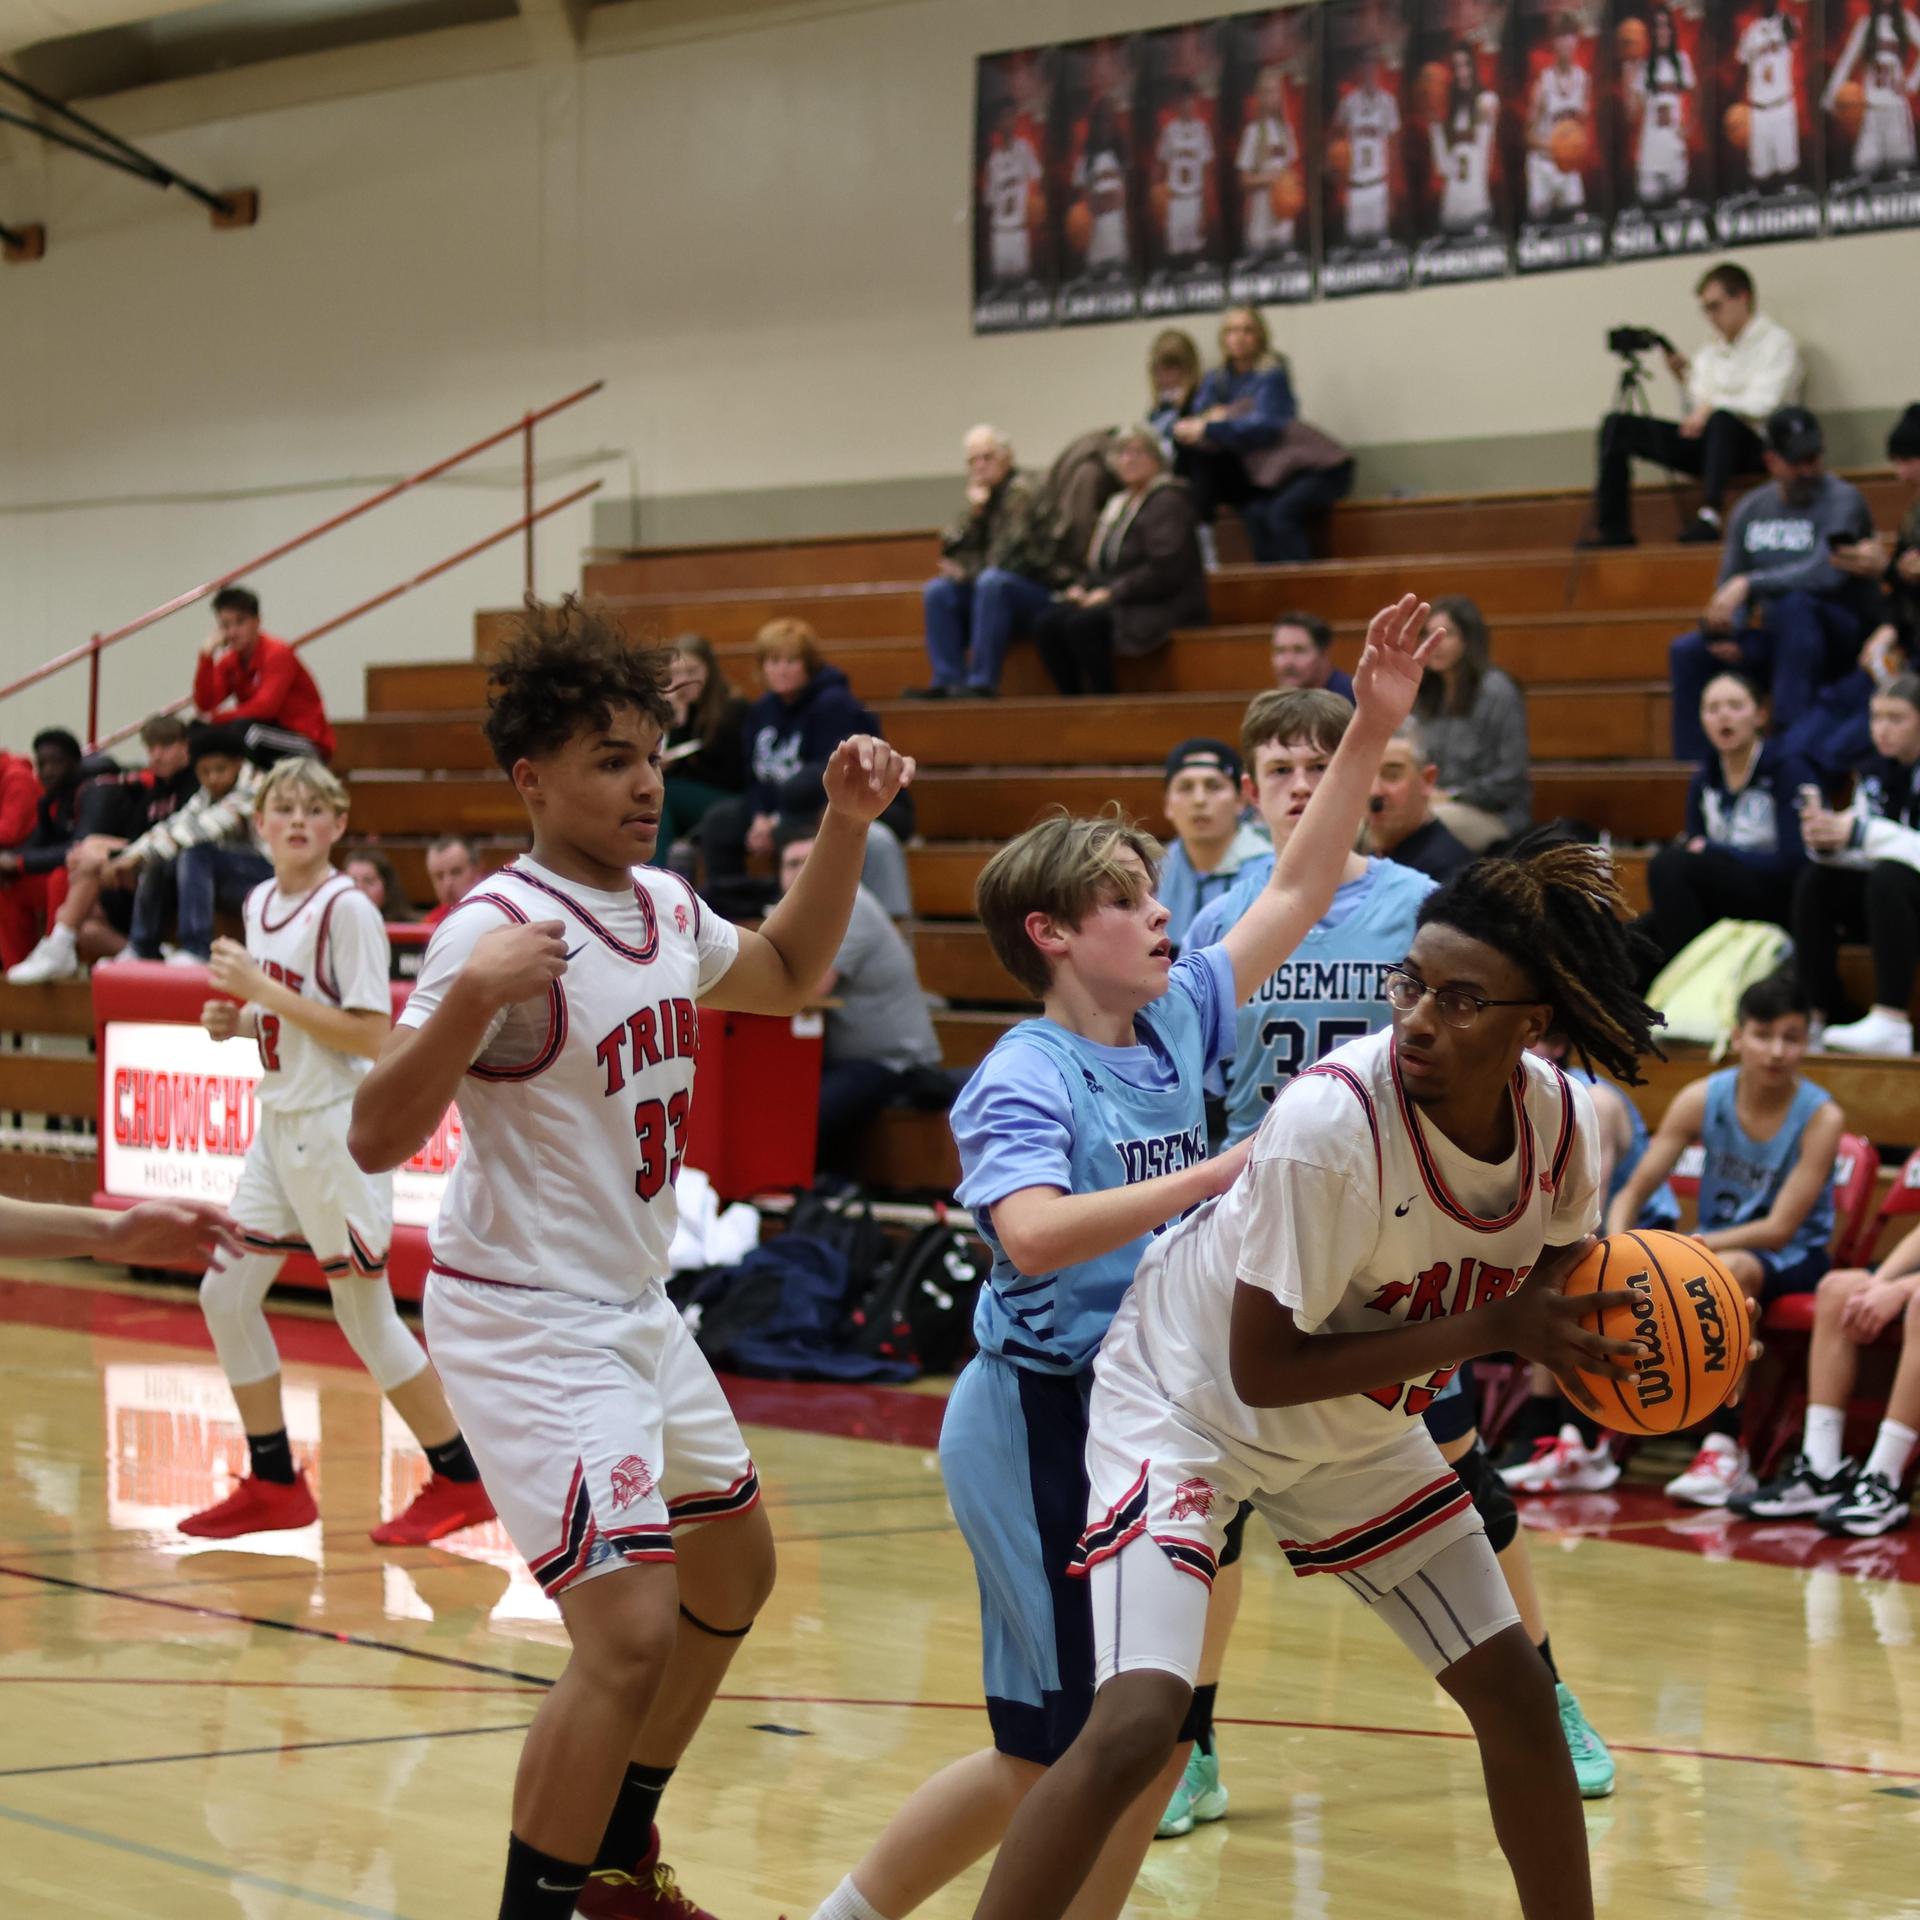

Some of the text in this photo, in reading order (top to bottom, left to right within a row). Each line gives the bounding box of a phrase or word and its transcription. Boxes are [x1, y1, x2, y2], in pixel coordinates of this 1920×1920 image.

[1611, 218, 1711, 256] SILVA
[1248, 962, 1404, 1004] OSEMITE
[596, 998, 699, 1096] TRIB
[143, 1162, 193, 1189] HIGH
[1624, 1270, 1675, 1409] Wilson
[1685, 1275, 1727, 1374] NCAA
